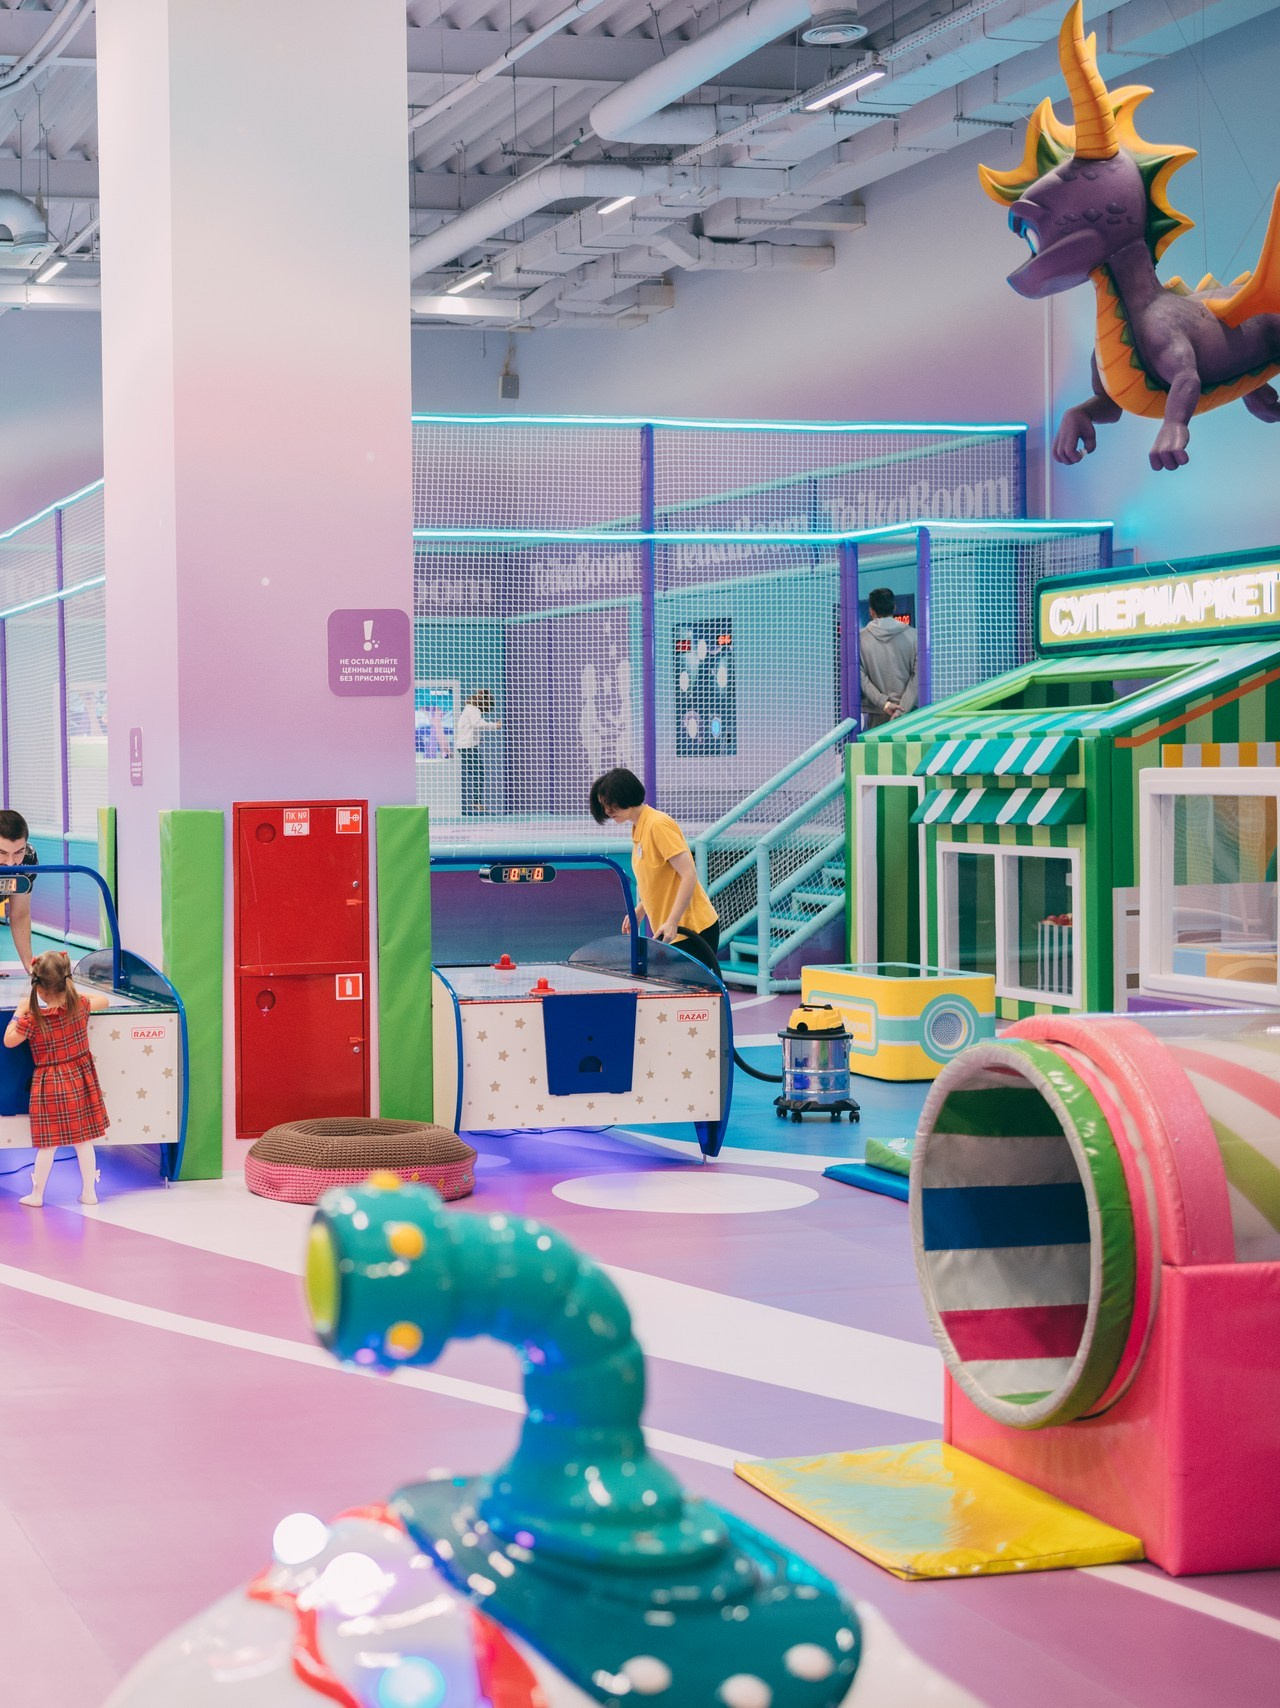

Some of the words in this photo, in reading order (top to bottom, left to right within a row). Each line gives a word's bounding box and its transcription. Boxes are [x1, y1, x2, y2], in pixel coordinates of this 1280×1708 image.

[1049, 571, 1280, 635] СУПЕРМАРКЕТ
[350, 657, 398, 665] ОСТАВЛЯЙТЕ
[285, 811, 296, 820] ПК
[291, 823, 303, 834] 42
